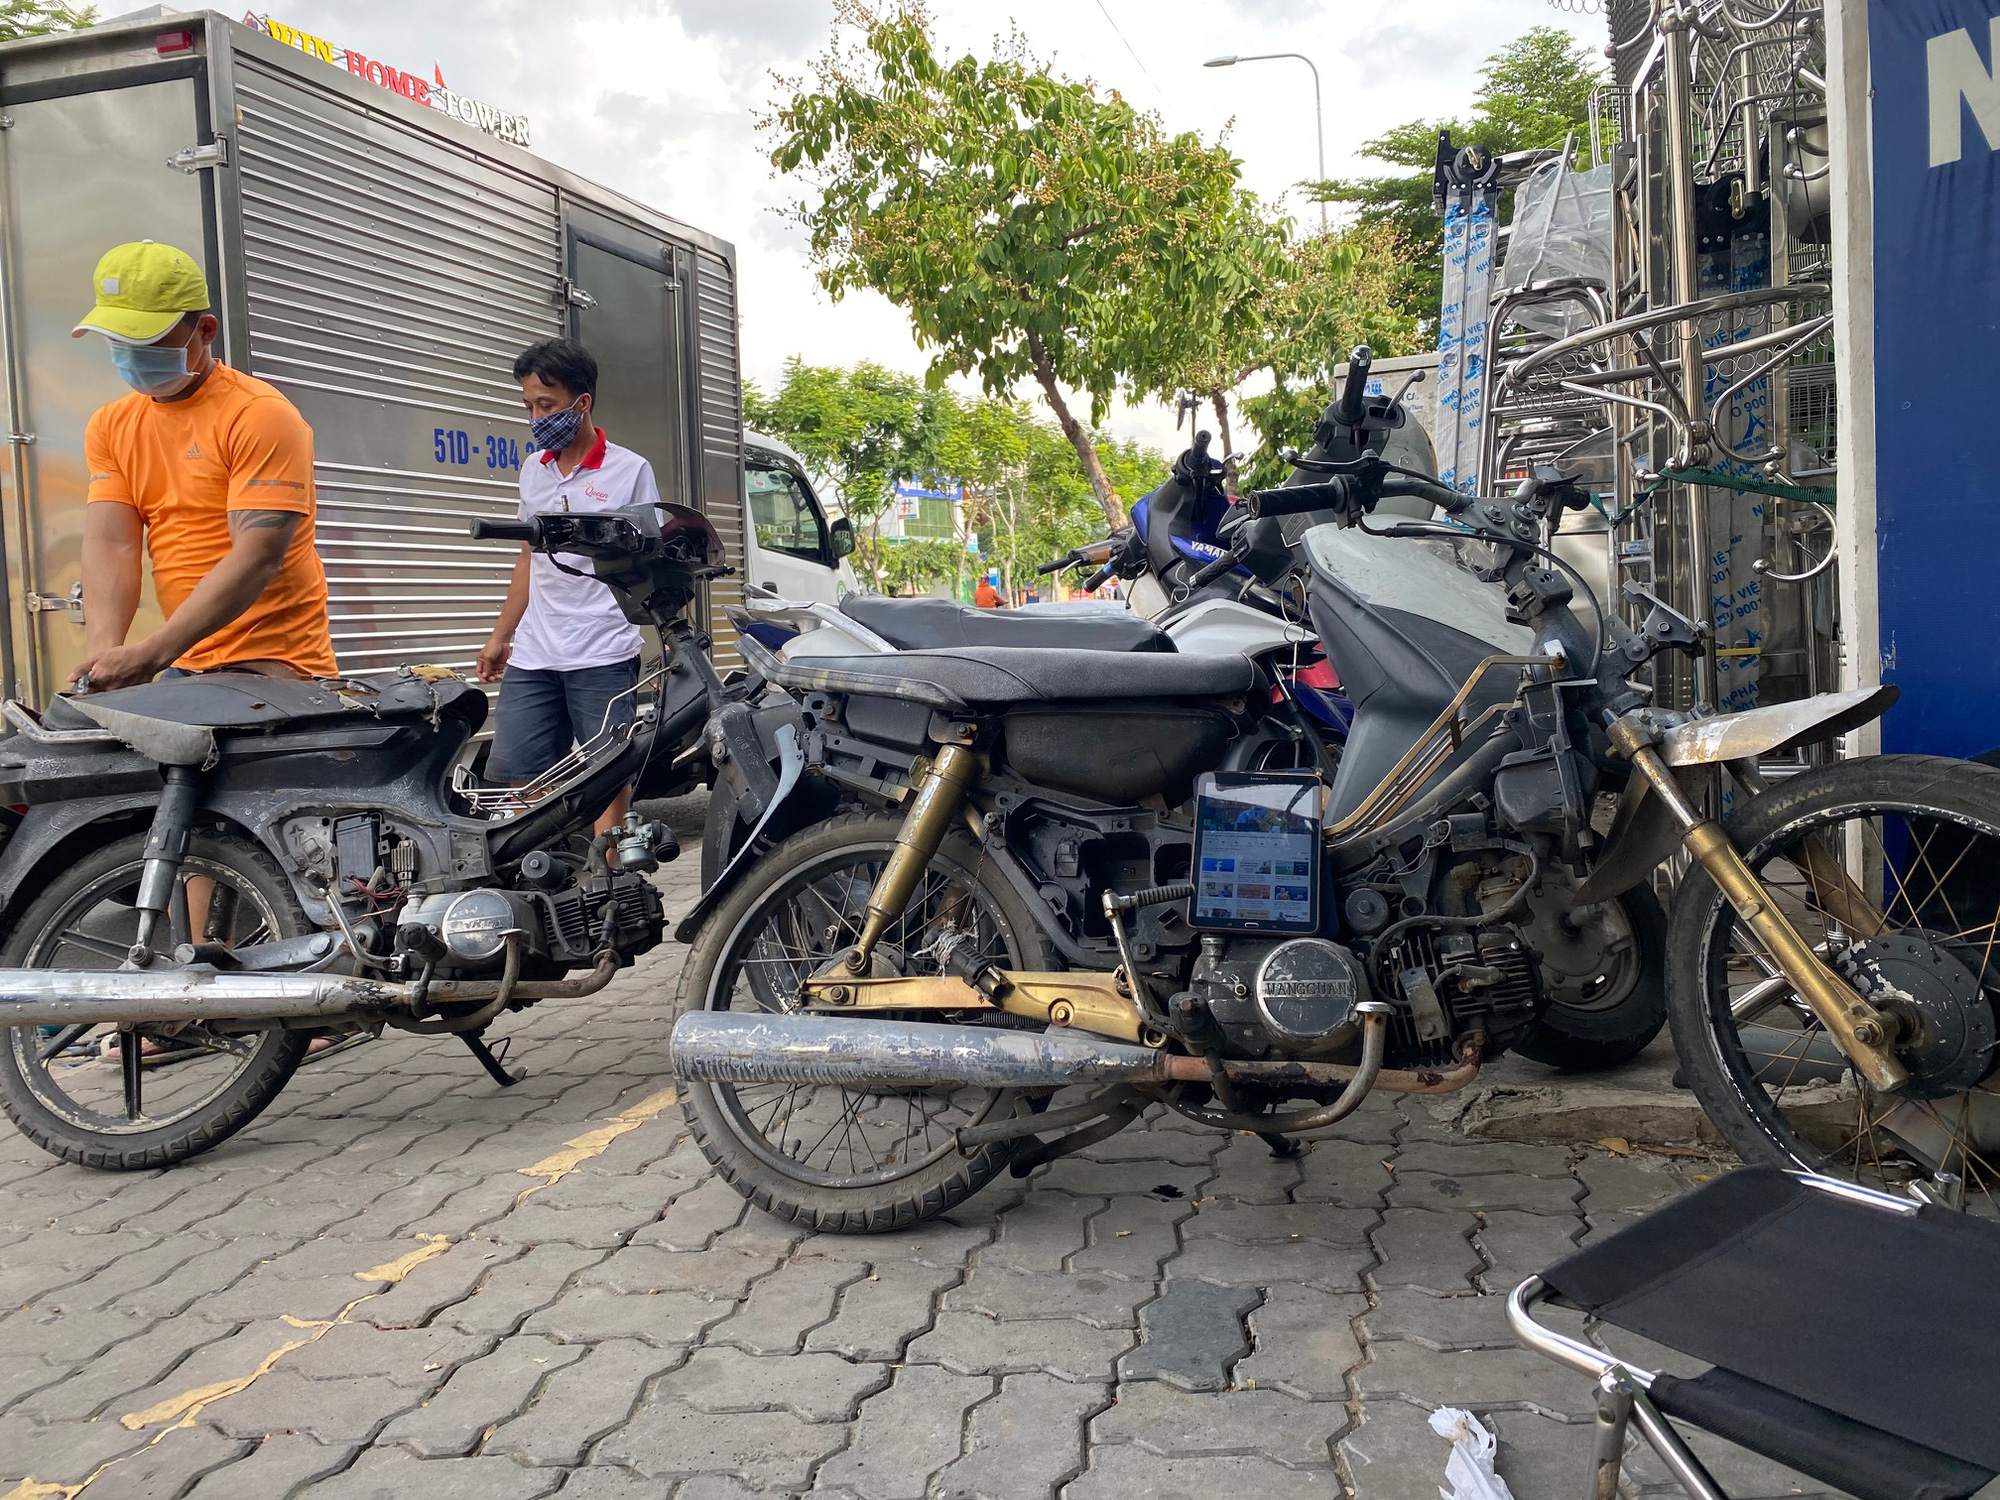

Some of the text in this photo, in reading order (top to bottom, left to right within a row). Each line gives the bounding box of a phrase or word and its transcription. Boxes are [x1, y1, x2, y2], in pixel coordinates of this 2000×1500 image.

[266, 18, 531, 146] WIN HOME TOWER
[1926, 16, 2000, 168] N
[1461, 400, 1480, 415] 2015
[585, 486, 608, 498] Queen
